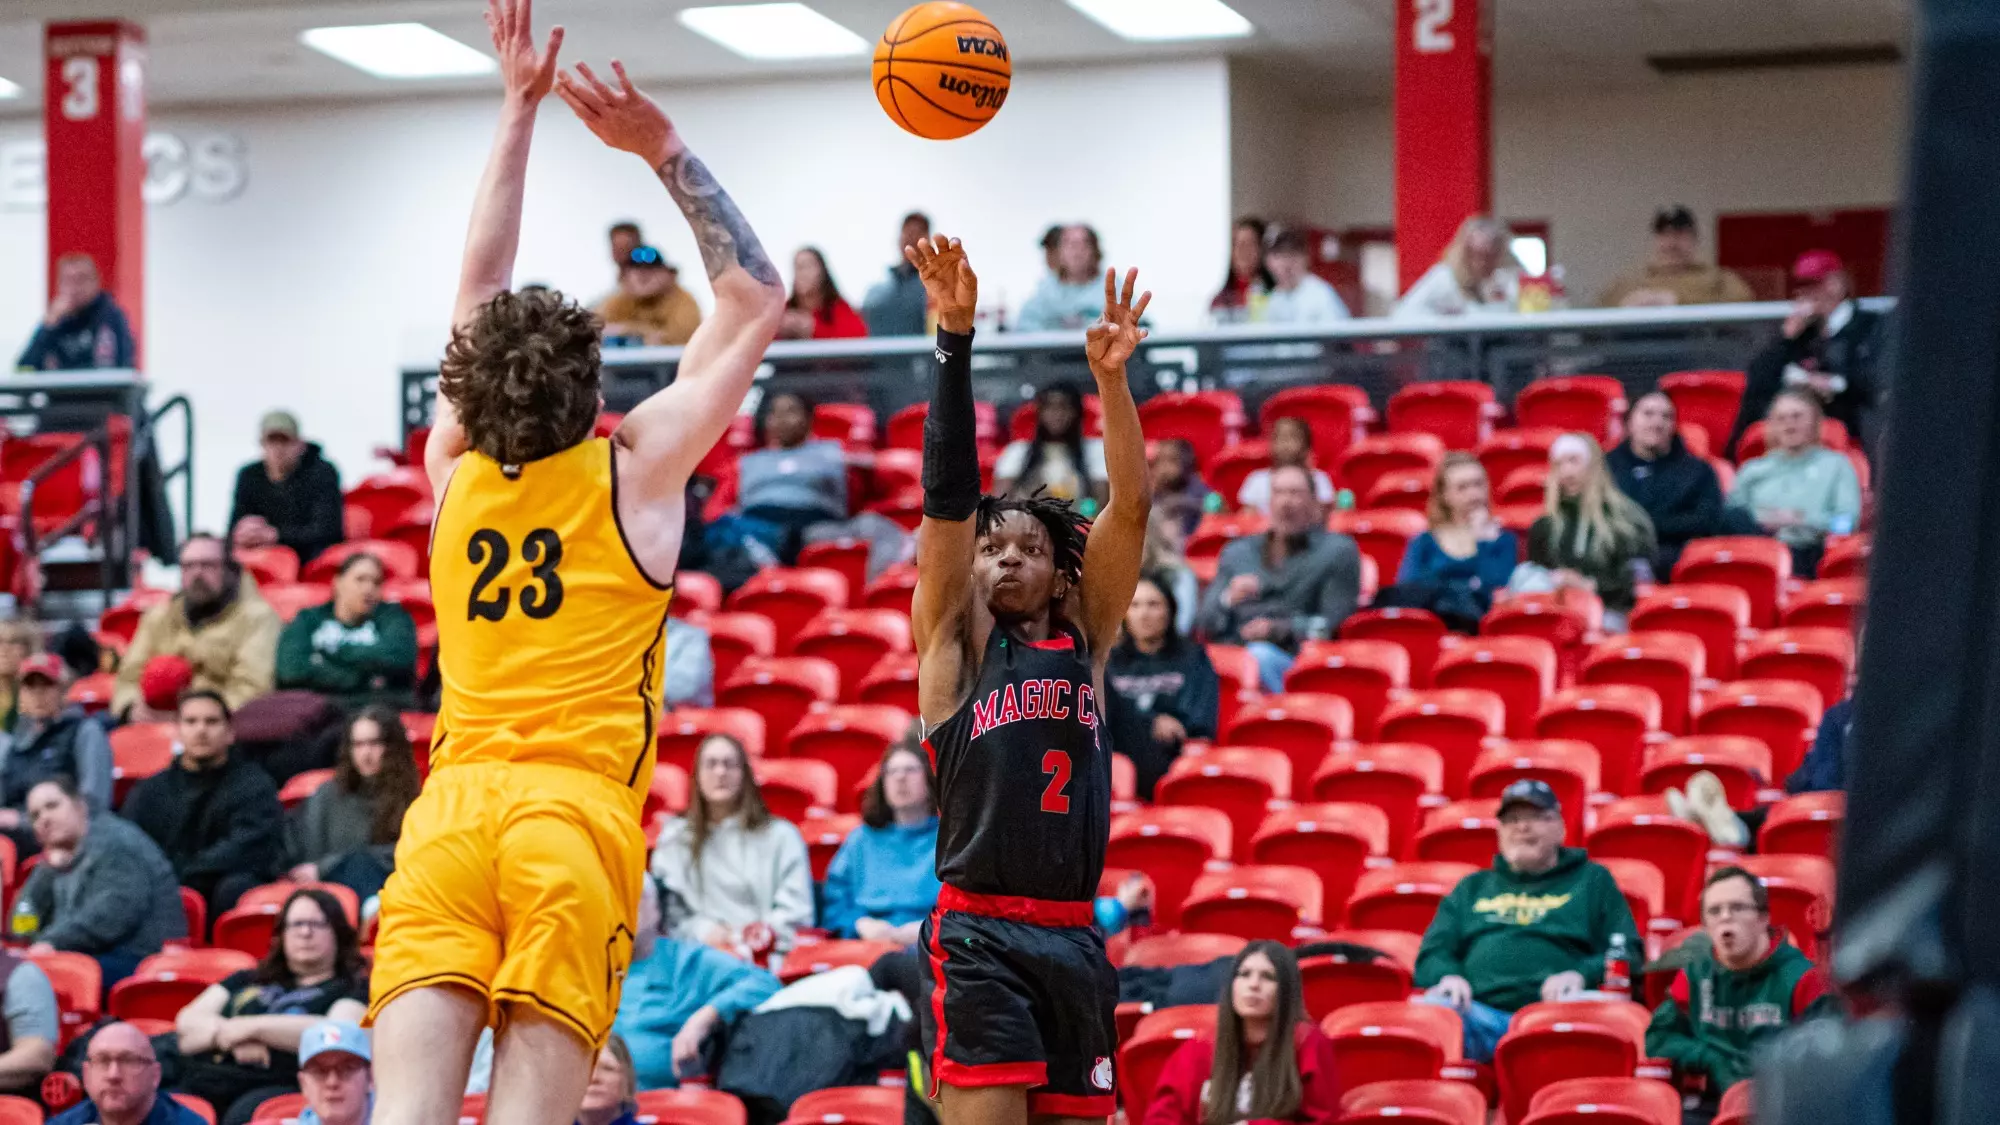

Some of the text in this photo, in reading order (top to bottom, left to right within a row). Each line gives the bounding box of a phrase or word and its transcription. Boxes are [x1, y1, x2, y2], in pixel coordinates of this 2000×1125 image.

[956, 35, 1008, 63] NCAA
[1413, 0, 1454, 53] 2
[63, 57, 98, 119] 3
[939, 72, 1009, 109] Wilson
[467, 527, 564, 622] 23
[970, 679, 1072, 741] MAGIC
[1040, 748, 1072, 814] 2
